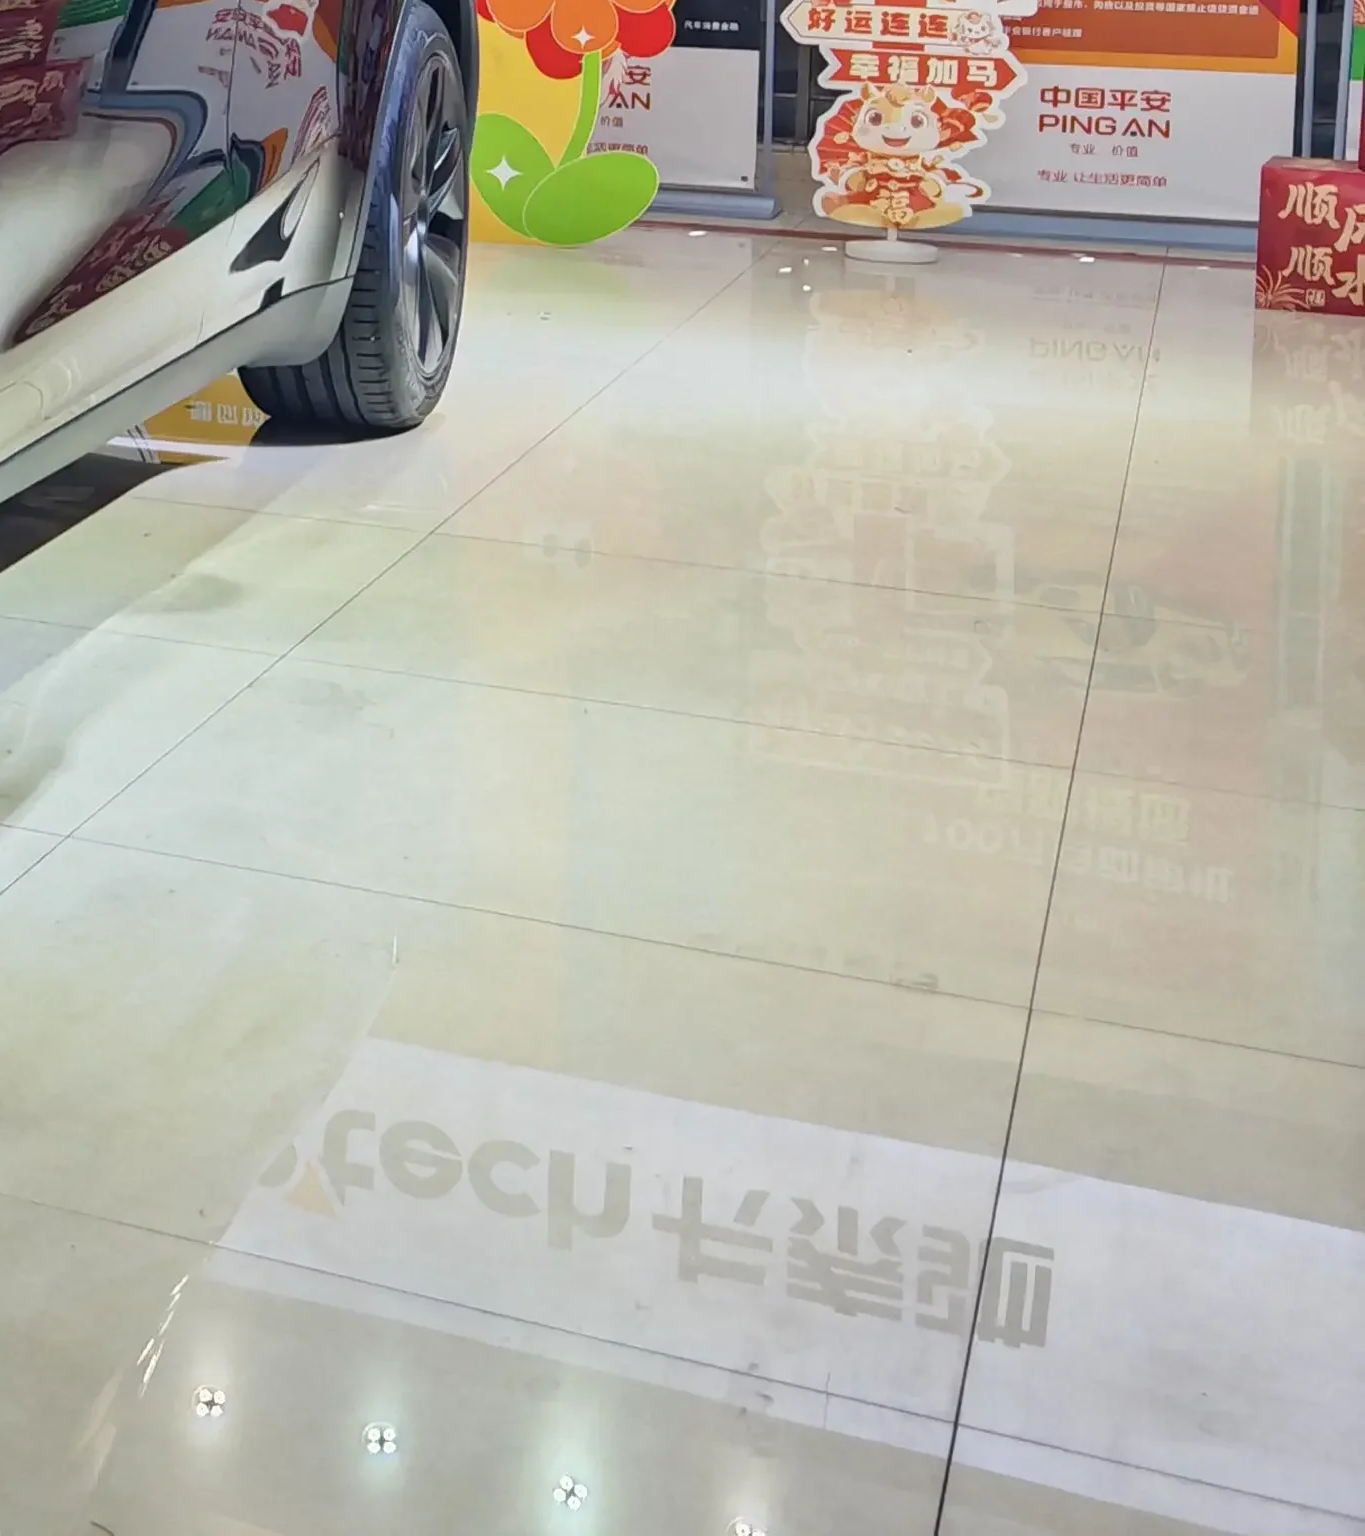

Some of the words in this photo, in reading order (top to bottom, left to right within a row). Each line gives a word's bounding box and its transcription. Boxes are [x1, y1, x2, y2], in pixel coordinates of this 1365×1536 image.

[807, 7, 950, 40] 好运连连
[849, 52, 999, 87] 幸福加马
[1039, 86, 1172, 112] 中国平安
